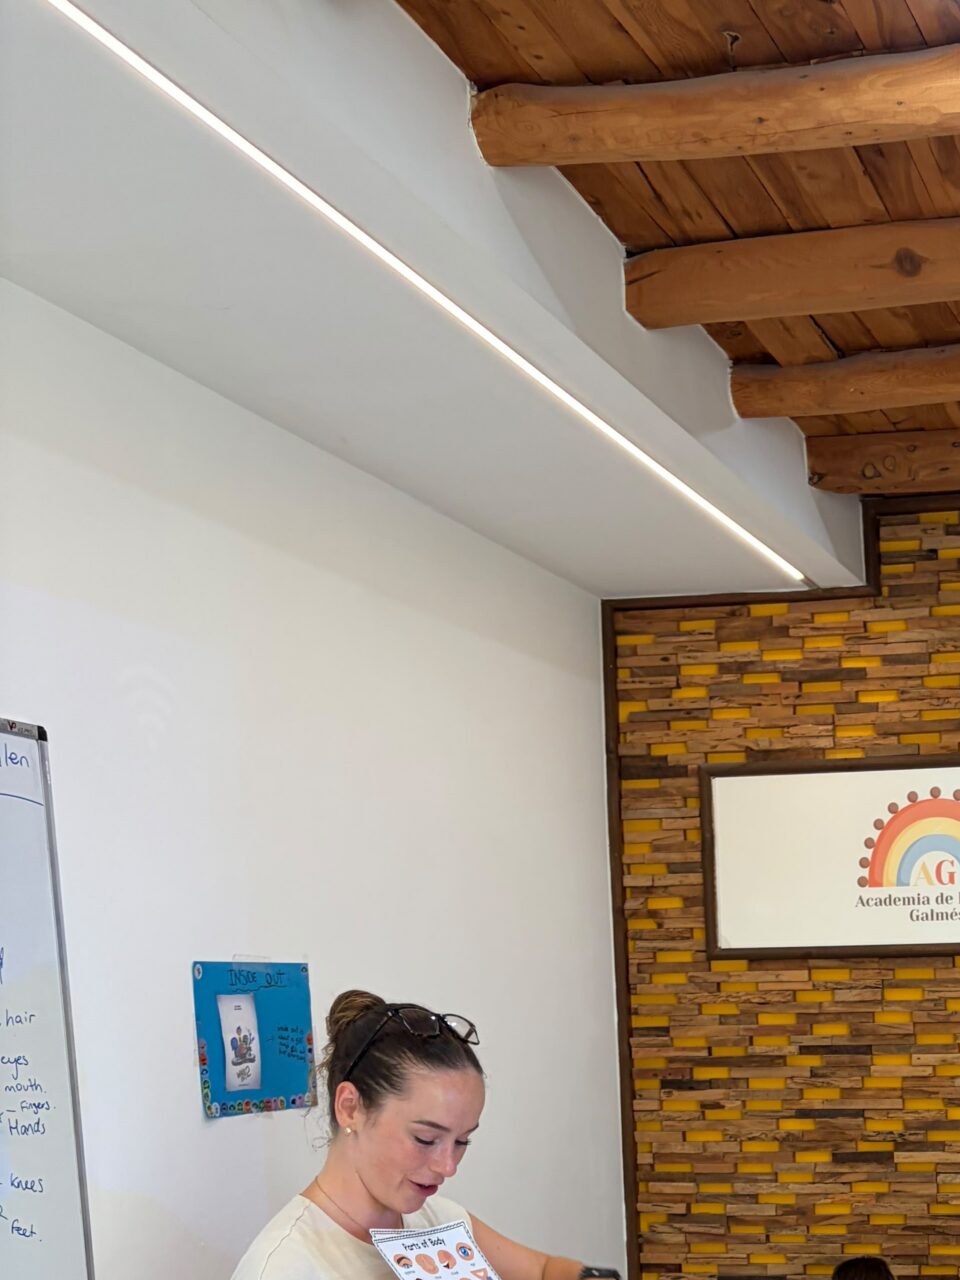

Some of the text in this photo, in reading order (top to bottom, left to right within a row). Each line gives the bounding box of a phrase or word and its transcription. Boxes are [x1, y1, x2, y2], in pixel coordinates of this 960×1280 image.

[0, 743, 30, 768] len
[913, 859, 956, 886] AG
[855, 893, 931, 908] Academia
[935, 892, 954, 905] de
[265, 970, 286, 985] OUT
[5, 1008, 36, 1027] hair
[0, 1055, 29, 1081] eyes
[8, 1117, 46, 1137] Hands
[402, 1237, 446, 1252] Parts of Body
